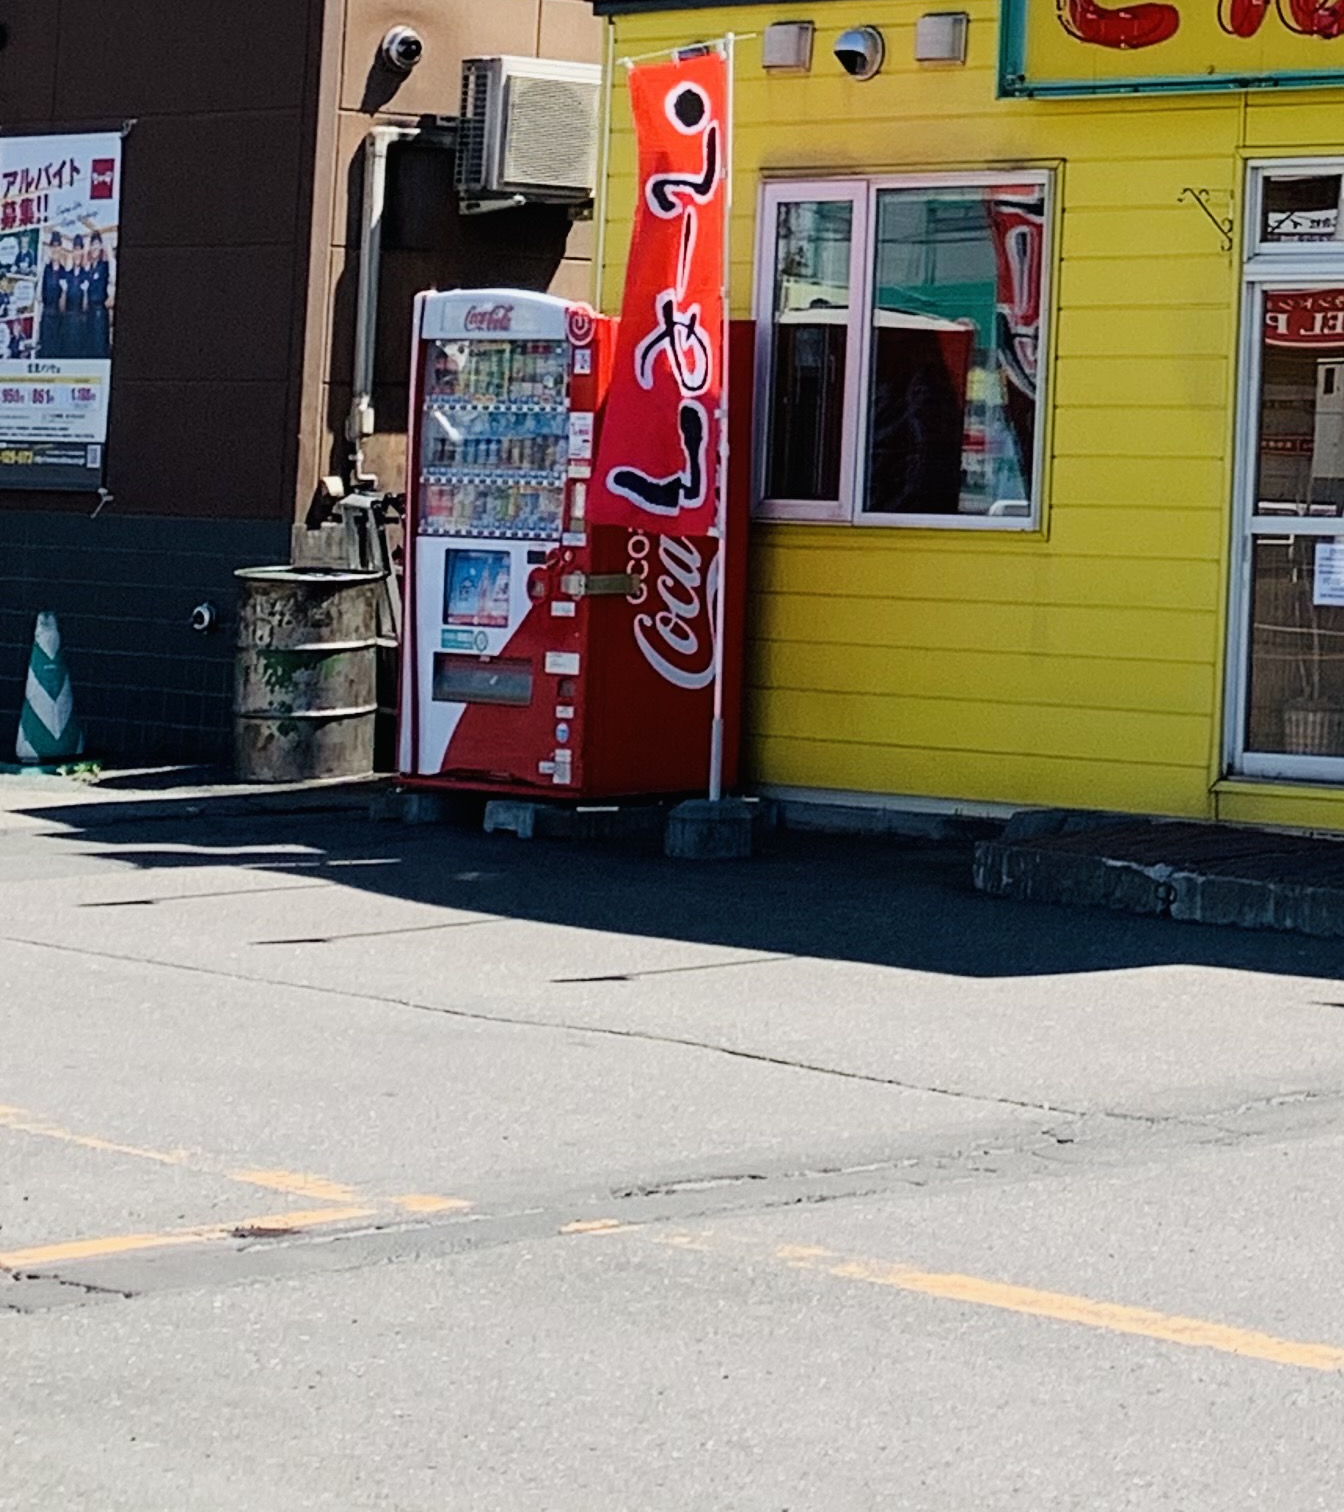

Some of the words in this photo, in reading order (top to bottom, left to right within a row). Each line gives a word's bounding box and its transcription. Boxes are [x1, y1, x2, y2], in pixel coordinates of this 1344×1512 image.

[2, 158, 80, 199] アルバイト
